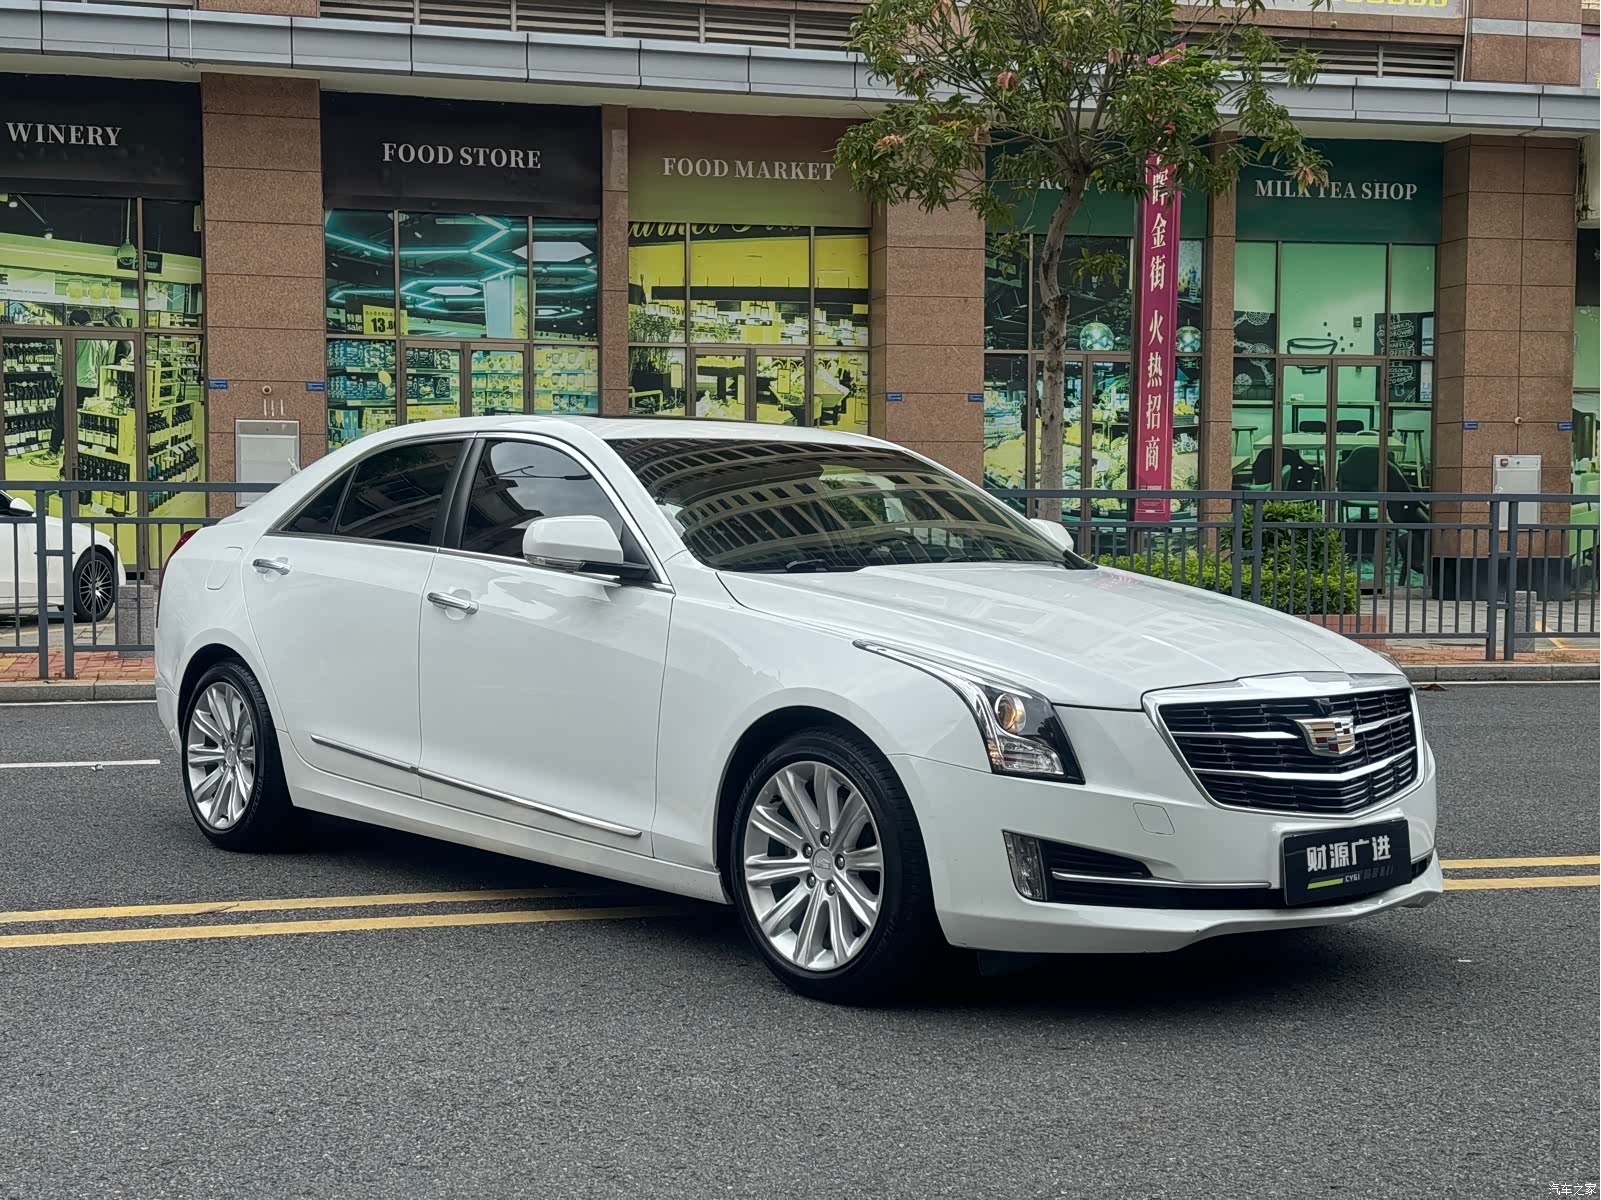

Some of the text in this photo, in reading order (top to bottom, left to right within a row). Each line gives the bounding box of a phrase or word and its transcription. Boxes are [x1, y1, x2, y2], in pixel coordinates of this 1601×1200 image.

[5, 122, 122, 146] WINERY
[382, 143, 541, 169] FOOD STORE
[663, 157, 836, 181] FOOD MARKET
[1361, 182, 1418, 200] SHOP
[1145, 309, 1164, 472] 火热招商
[1306, 835, 1391, 872] 财源广进
